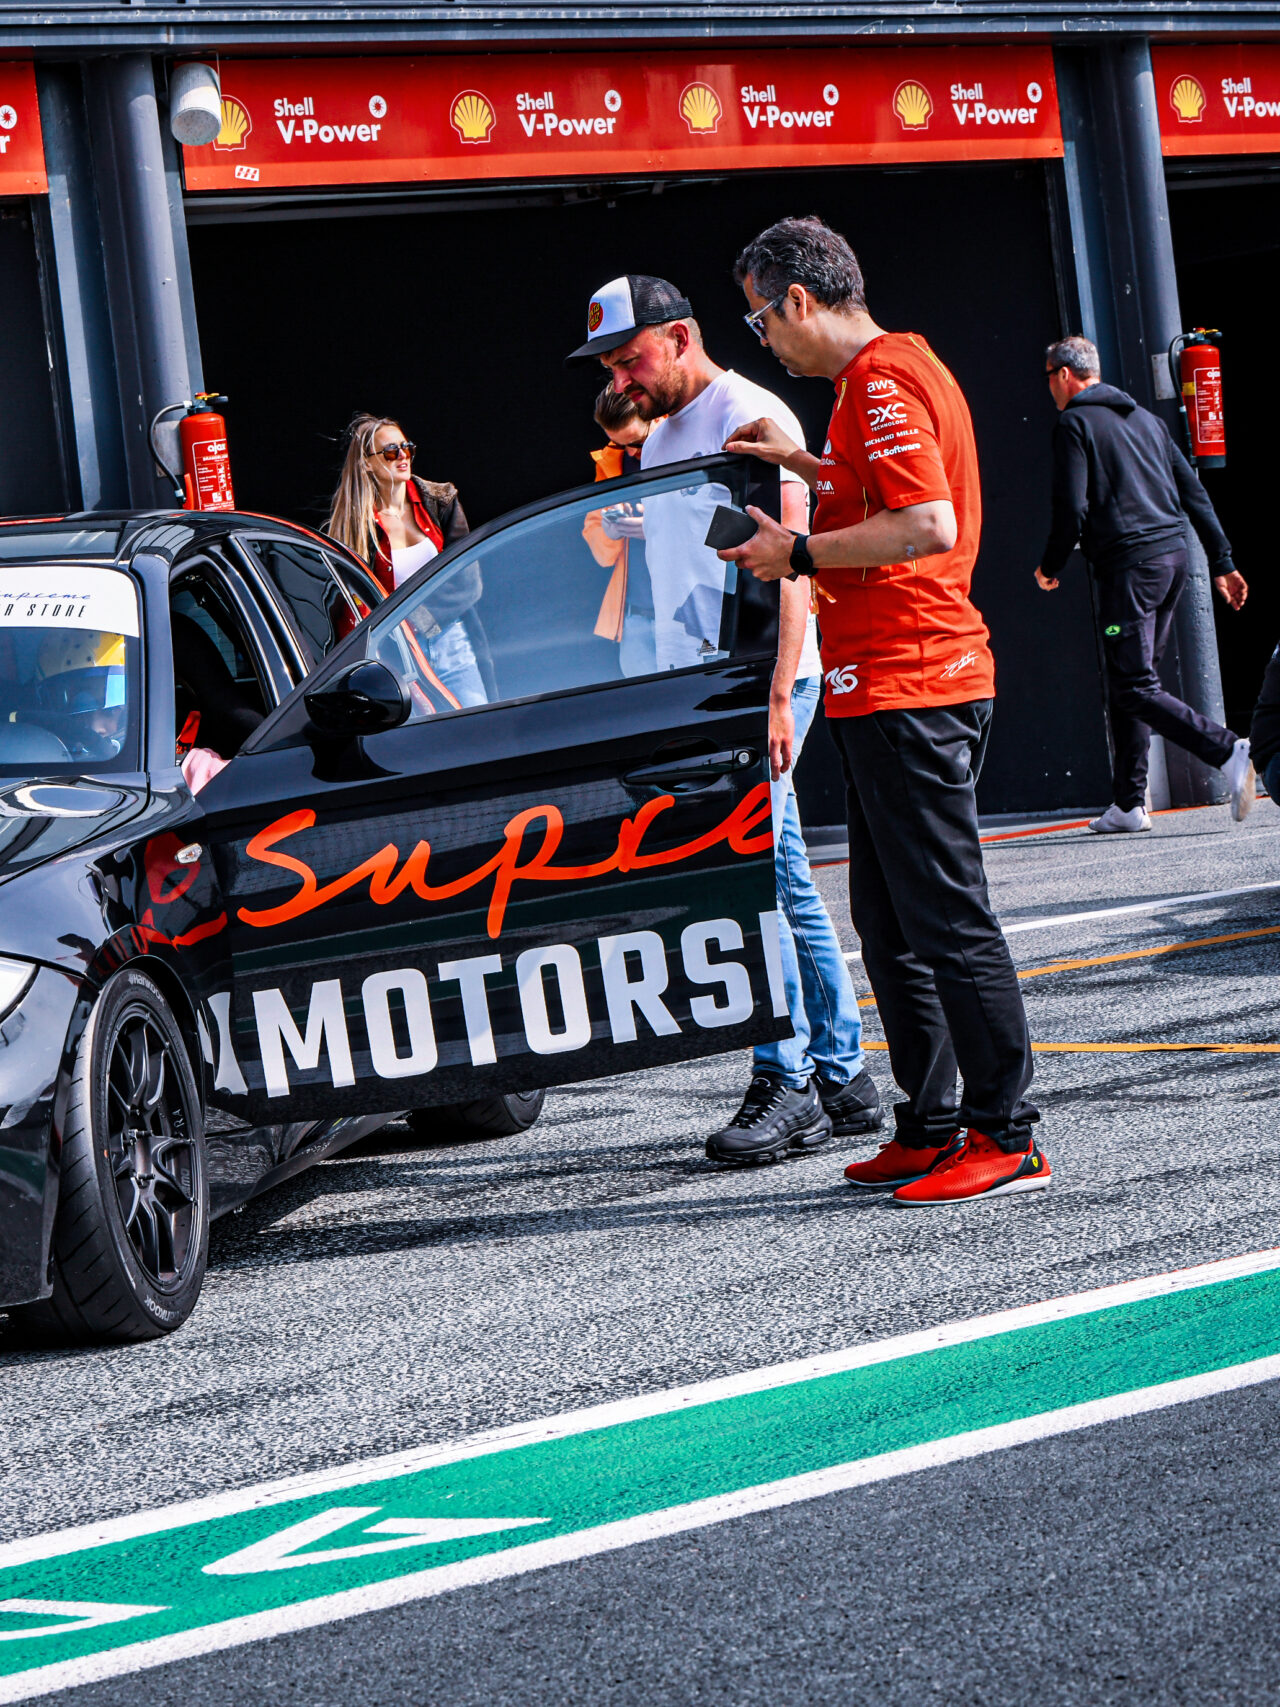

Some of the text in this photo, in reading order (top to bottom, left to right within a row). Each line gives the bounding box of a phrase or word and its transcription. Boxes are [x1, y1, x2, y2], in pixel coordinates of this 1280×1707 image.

[741, 85, 776, 102] Shell
[951, 83, 983, 100] Shell
[1221, 77, 1251, 94] Shell
[274, 97, 314, 116] Shell
[516, 92, 553, 110] Shell
[743, 106, 834, 128] V-Power
[953, 103, 1037, 125] V-Power
[276, 119, 381, 144] V-Power
[519, 113, 616, 137] V-Power
[867, 379, 897, 393] aws
[867, 402, 907, 427] DXC
[871, 418, 908, 432] TECHNOLOGY
[864, 428, 919, 448] RICHARD MILLE
[867, 443, 921, 462] HCLSoftware
[26, 603, 87, 618] STORE
[825, 664, 858, 695] 16
